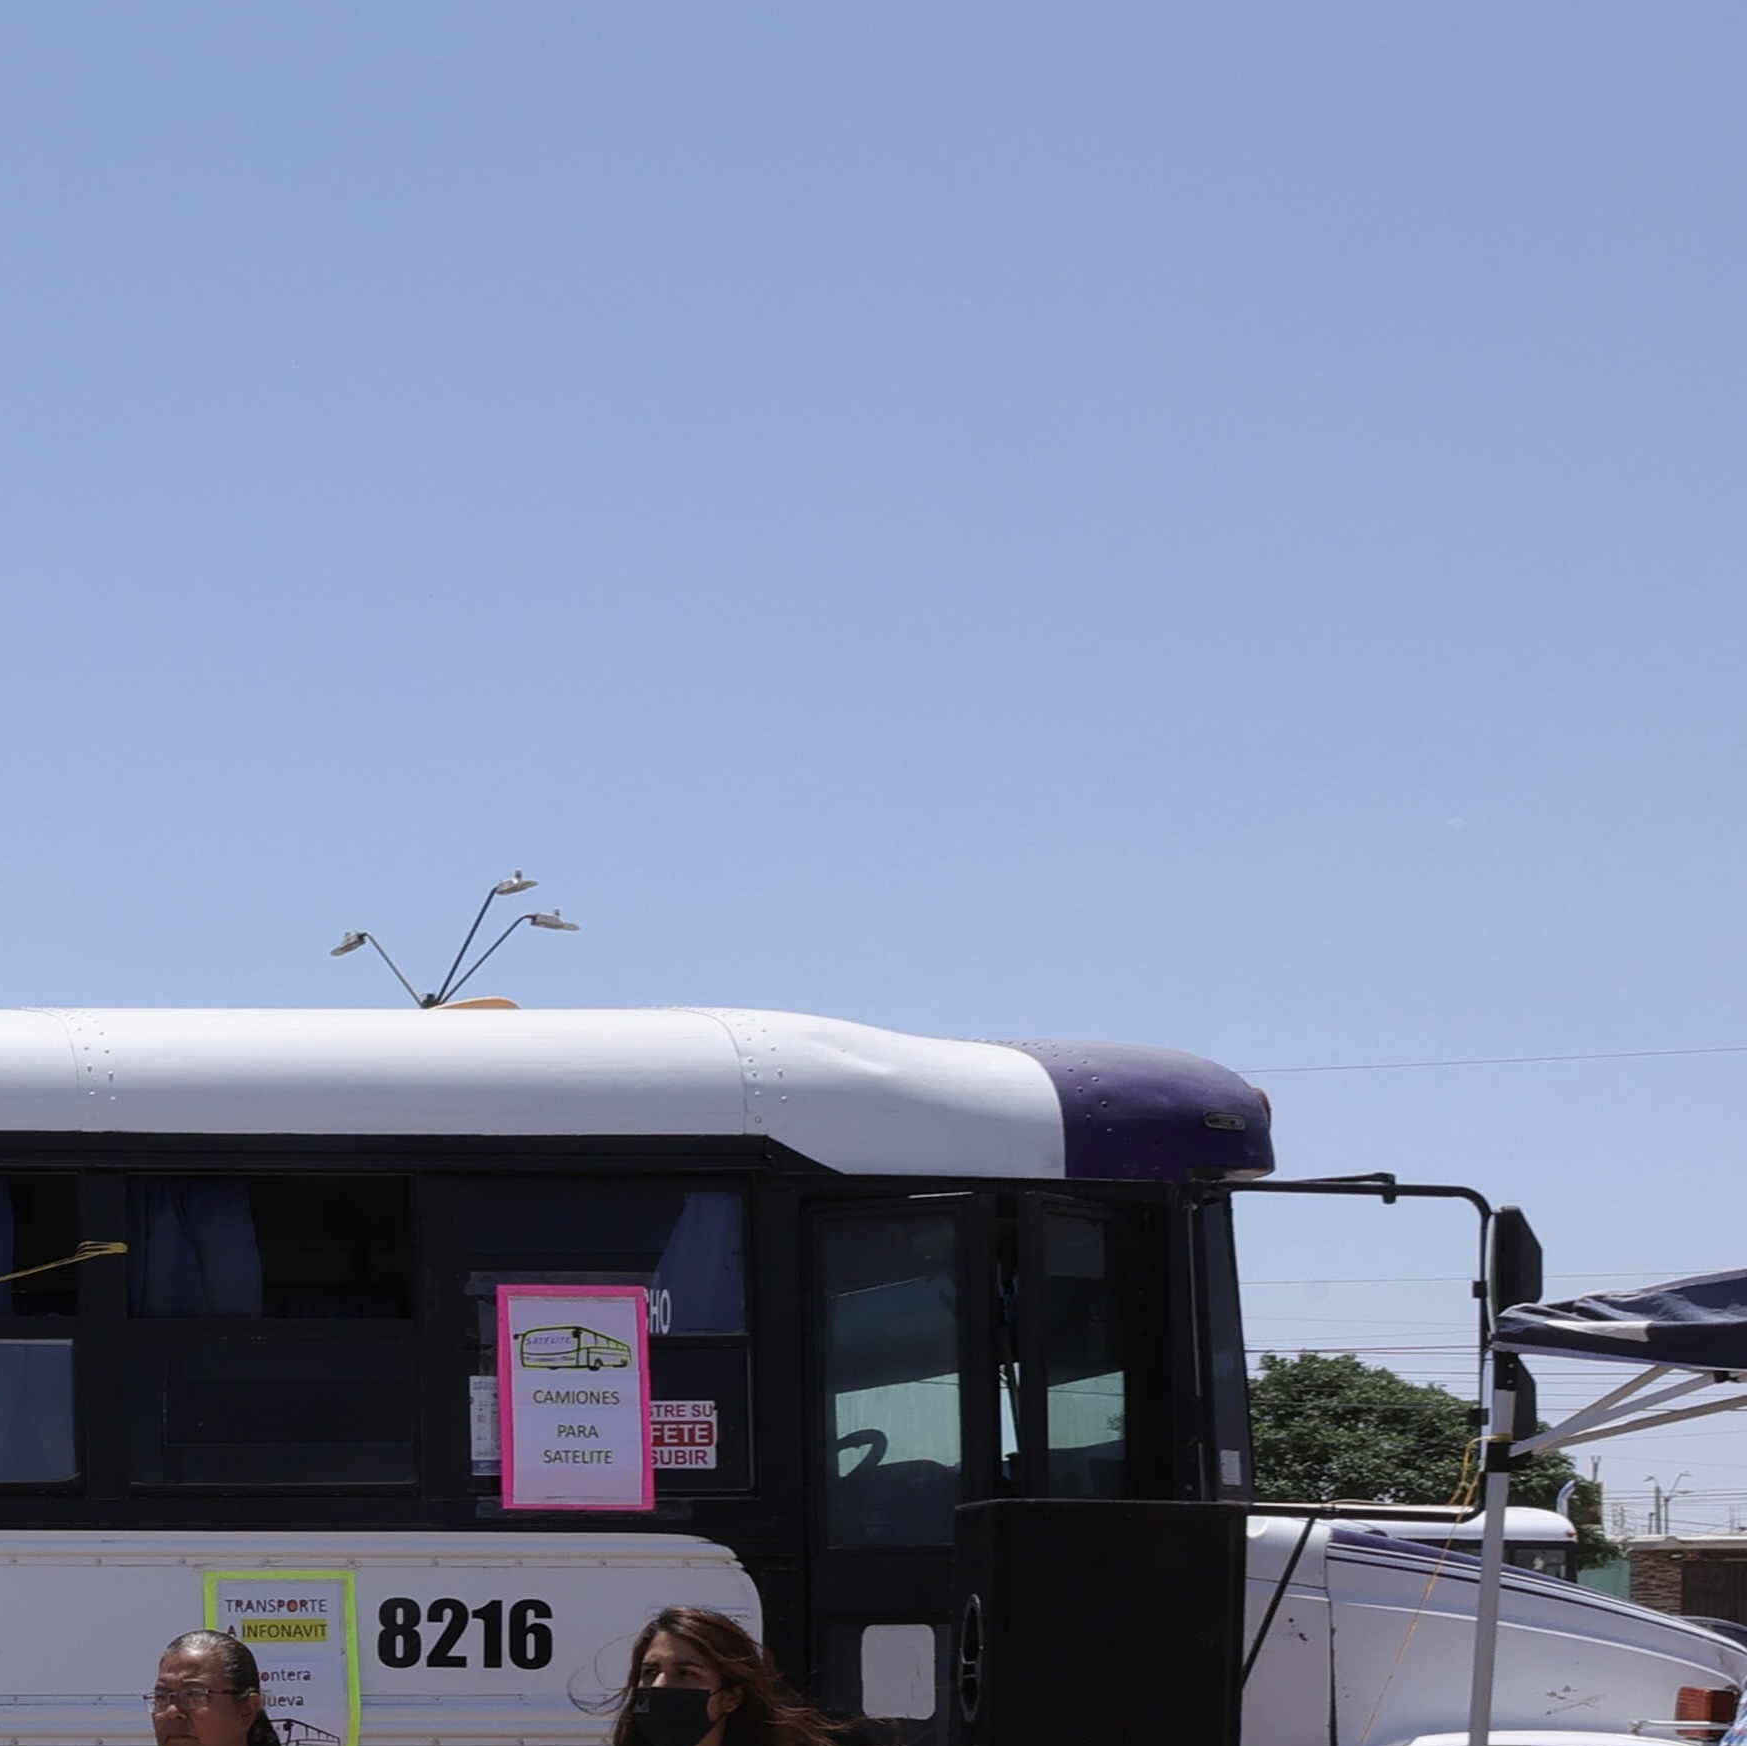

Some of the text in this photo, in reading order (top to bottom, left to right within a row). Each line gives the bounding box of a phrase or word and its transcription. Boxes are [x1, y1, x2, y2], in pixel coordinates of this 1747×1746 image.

[533, 1389, 620, 1405] CAMIONES
[691, 1404, 713, 1418] SU
[557, 1424, 599, 1438] PARA
[651, 1424, 710, 1443] FETE
[543, 1449, 613, 1464] SATELITE
[224, 1599, 328, 1613] TRANSPORTE
[226, 1623, 328, 1639] A INFONAVIT
[377, 1597, 554, 1670] 8216
